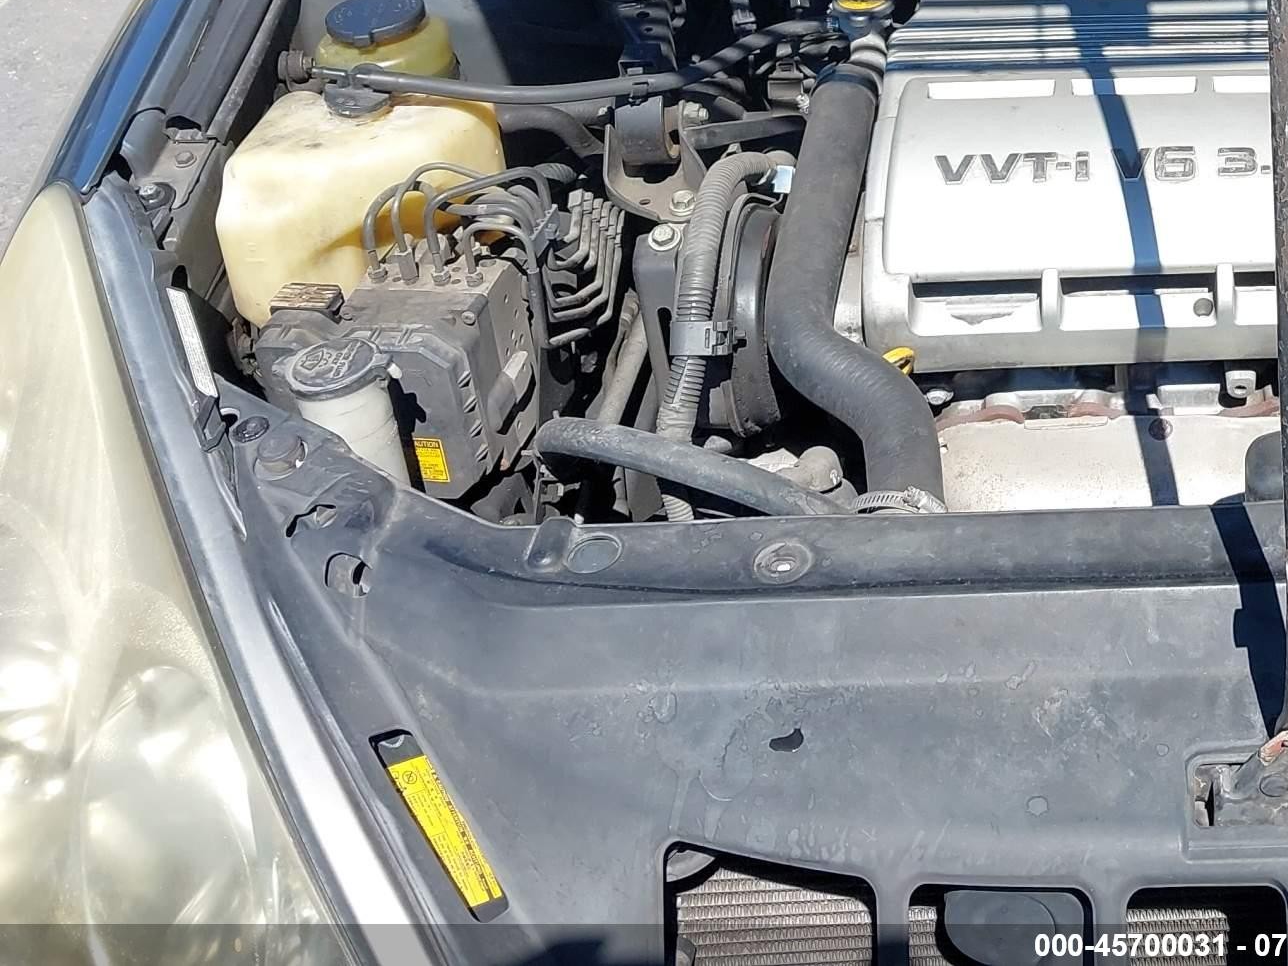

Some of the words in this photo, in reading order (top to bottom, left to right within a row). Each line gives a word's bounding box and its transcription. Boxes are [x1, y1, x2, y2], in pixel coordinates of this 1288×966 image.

[935, 150, 1091, 184] VVT-i
[1111, 145, 1197, 182] V6
[1216, 146, 1272, 178] 3.
[415, 440, 440, 448] AUTION
